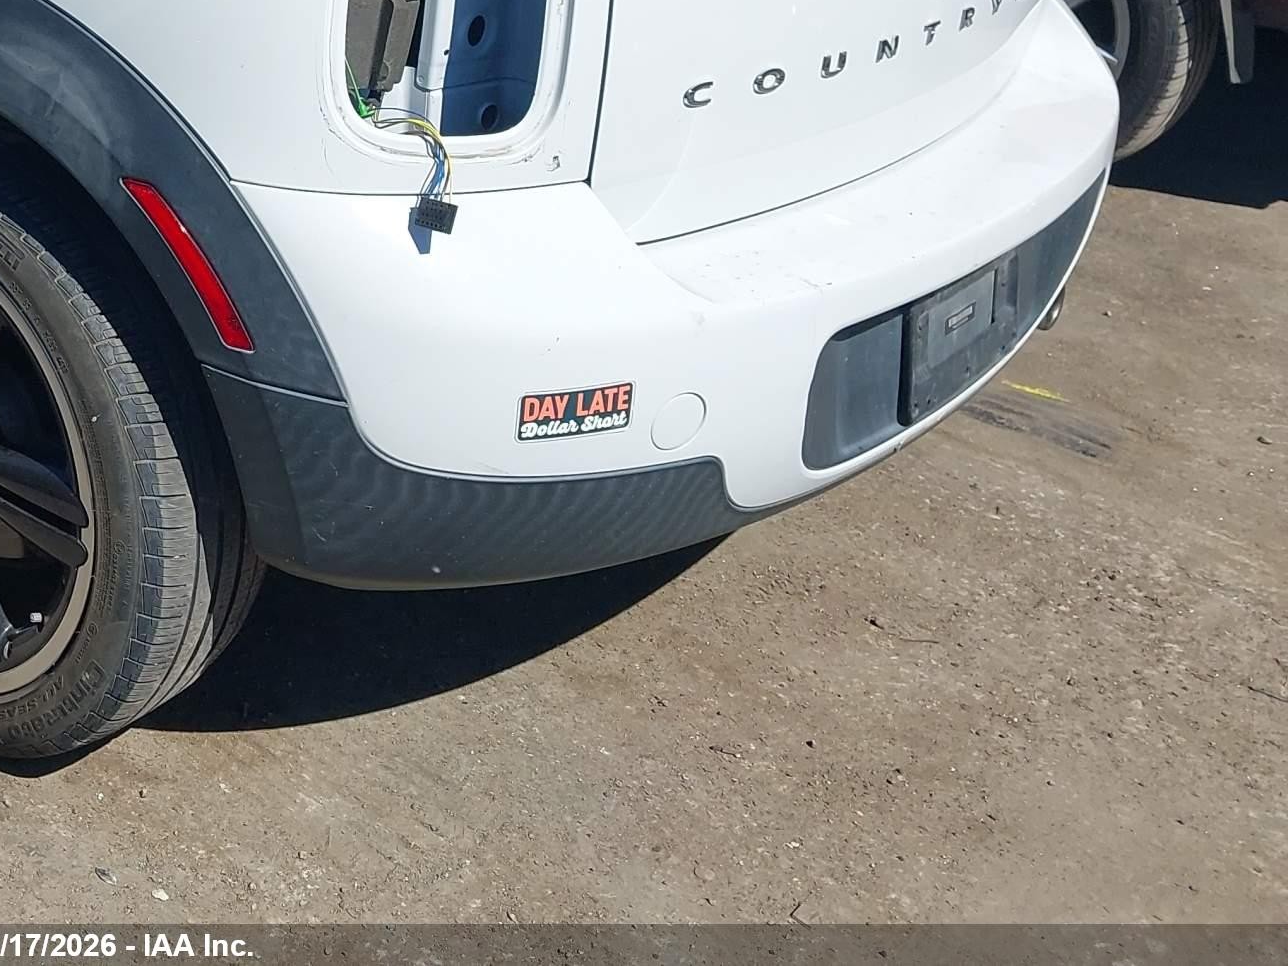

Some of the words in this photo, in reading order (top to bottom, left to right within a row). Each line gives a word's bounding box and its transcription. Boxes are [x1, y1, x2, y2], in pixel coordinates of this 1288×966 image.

[523, 394, 570, 422] DAY
[576, 385, 631, 417] LATE
[520, 420, 580, 438] Dollar
[581, 411, 628, 432] Short
